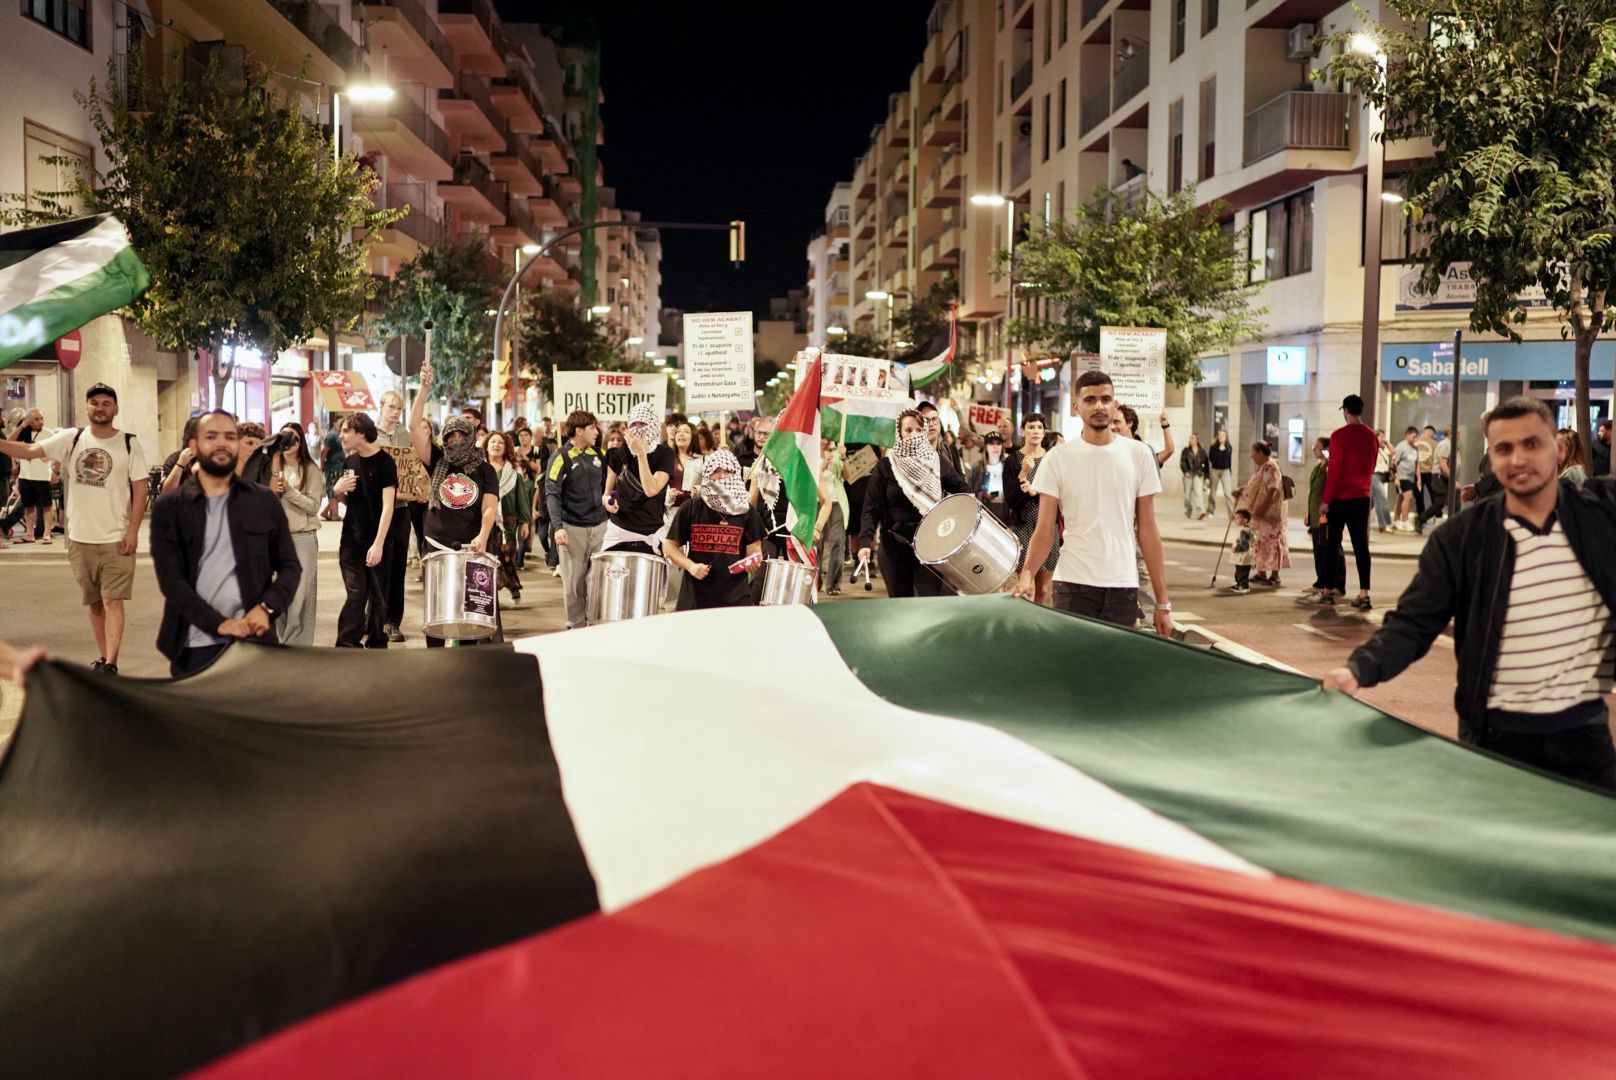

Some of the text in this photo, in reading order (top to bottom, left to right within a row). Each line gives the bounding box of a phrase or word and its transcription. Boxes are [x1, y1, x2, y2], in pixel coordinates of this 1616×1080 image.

[1408, 358, 1489, 376] Sabadell
[598, 374, 632, 386] FREE
[693, 534, 738, 544] POPULAR
